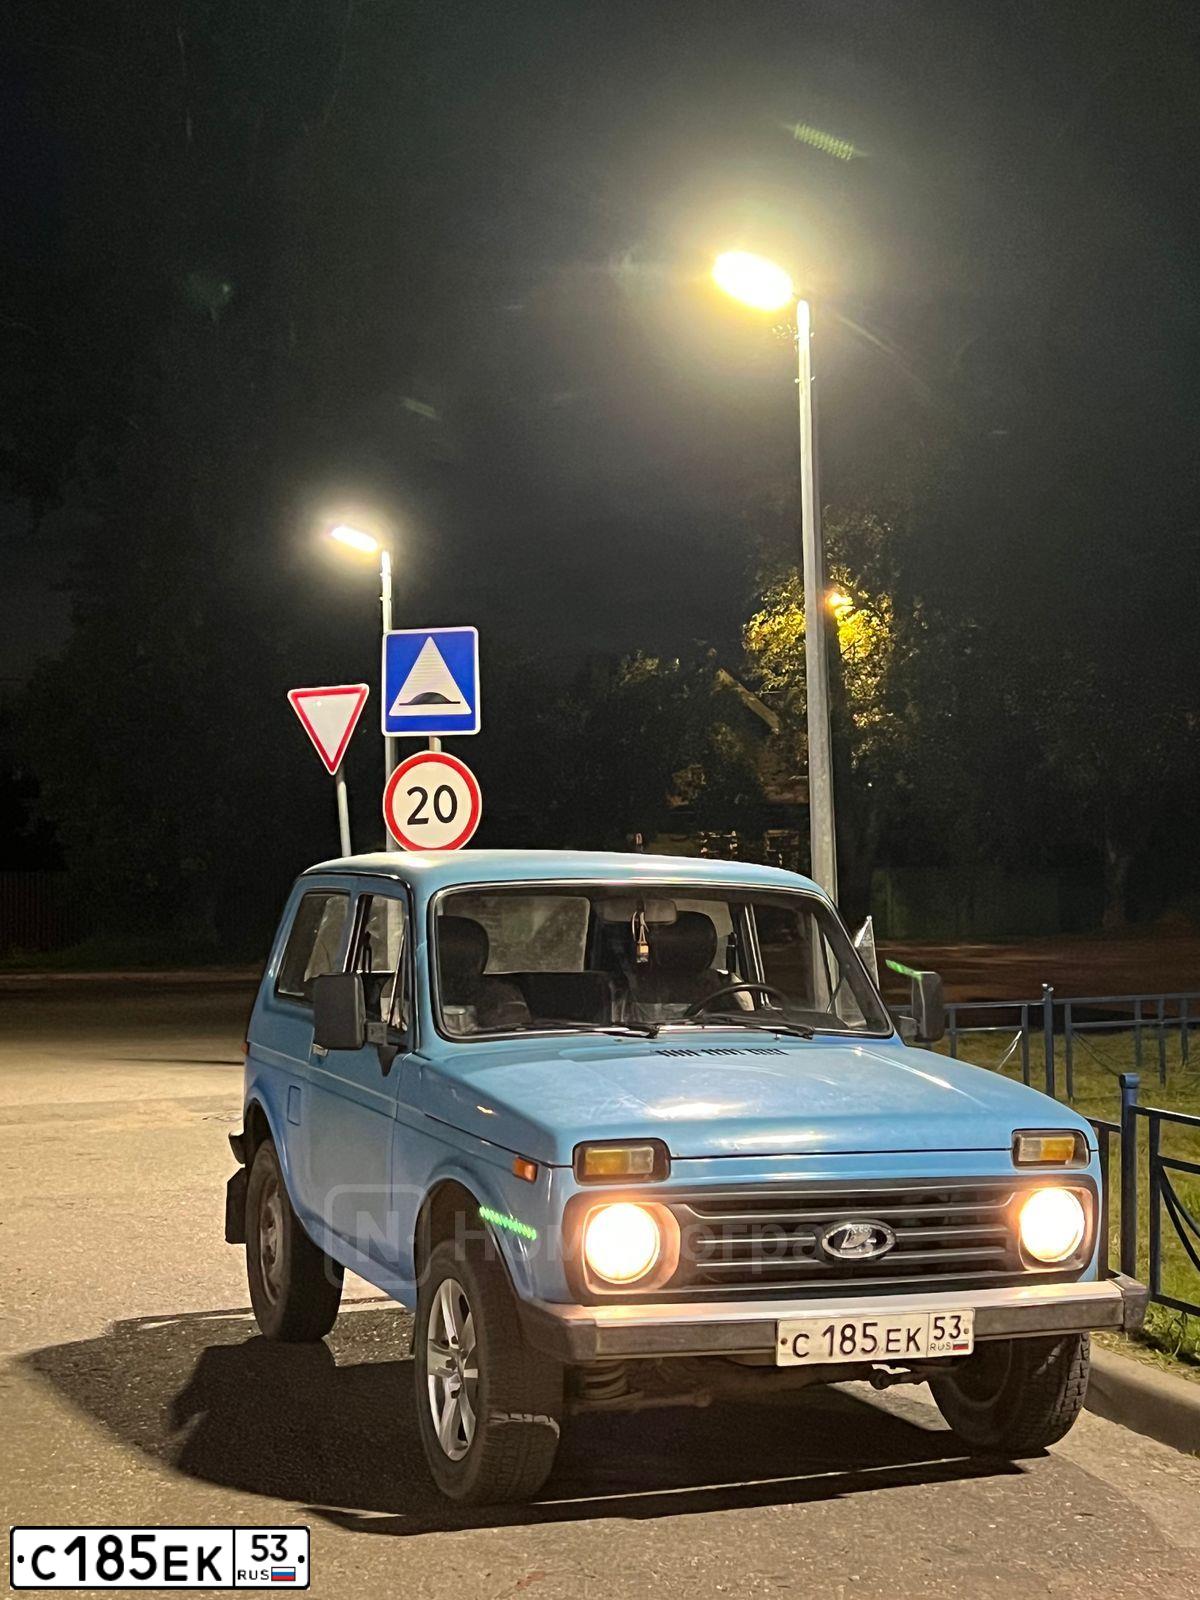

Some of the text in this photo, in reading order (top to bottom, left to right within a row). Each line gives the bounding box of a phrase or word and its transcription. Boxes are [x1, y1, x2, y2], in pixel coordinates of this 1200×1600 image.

[406, 784, 458, 826] 20
[933, 1315, 962, 1341] 53
[929, 1341, 951, 1351] RUS
